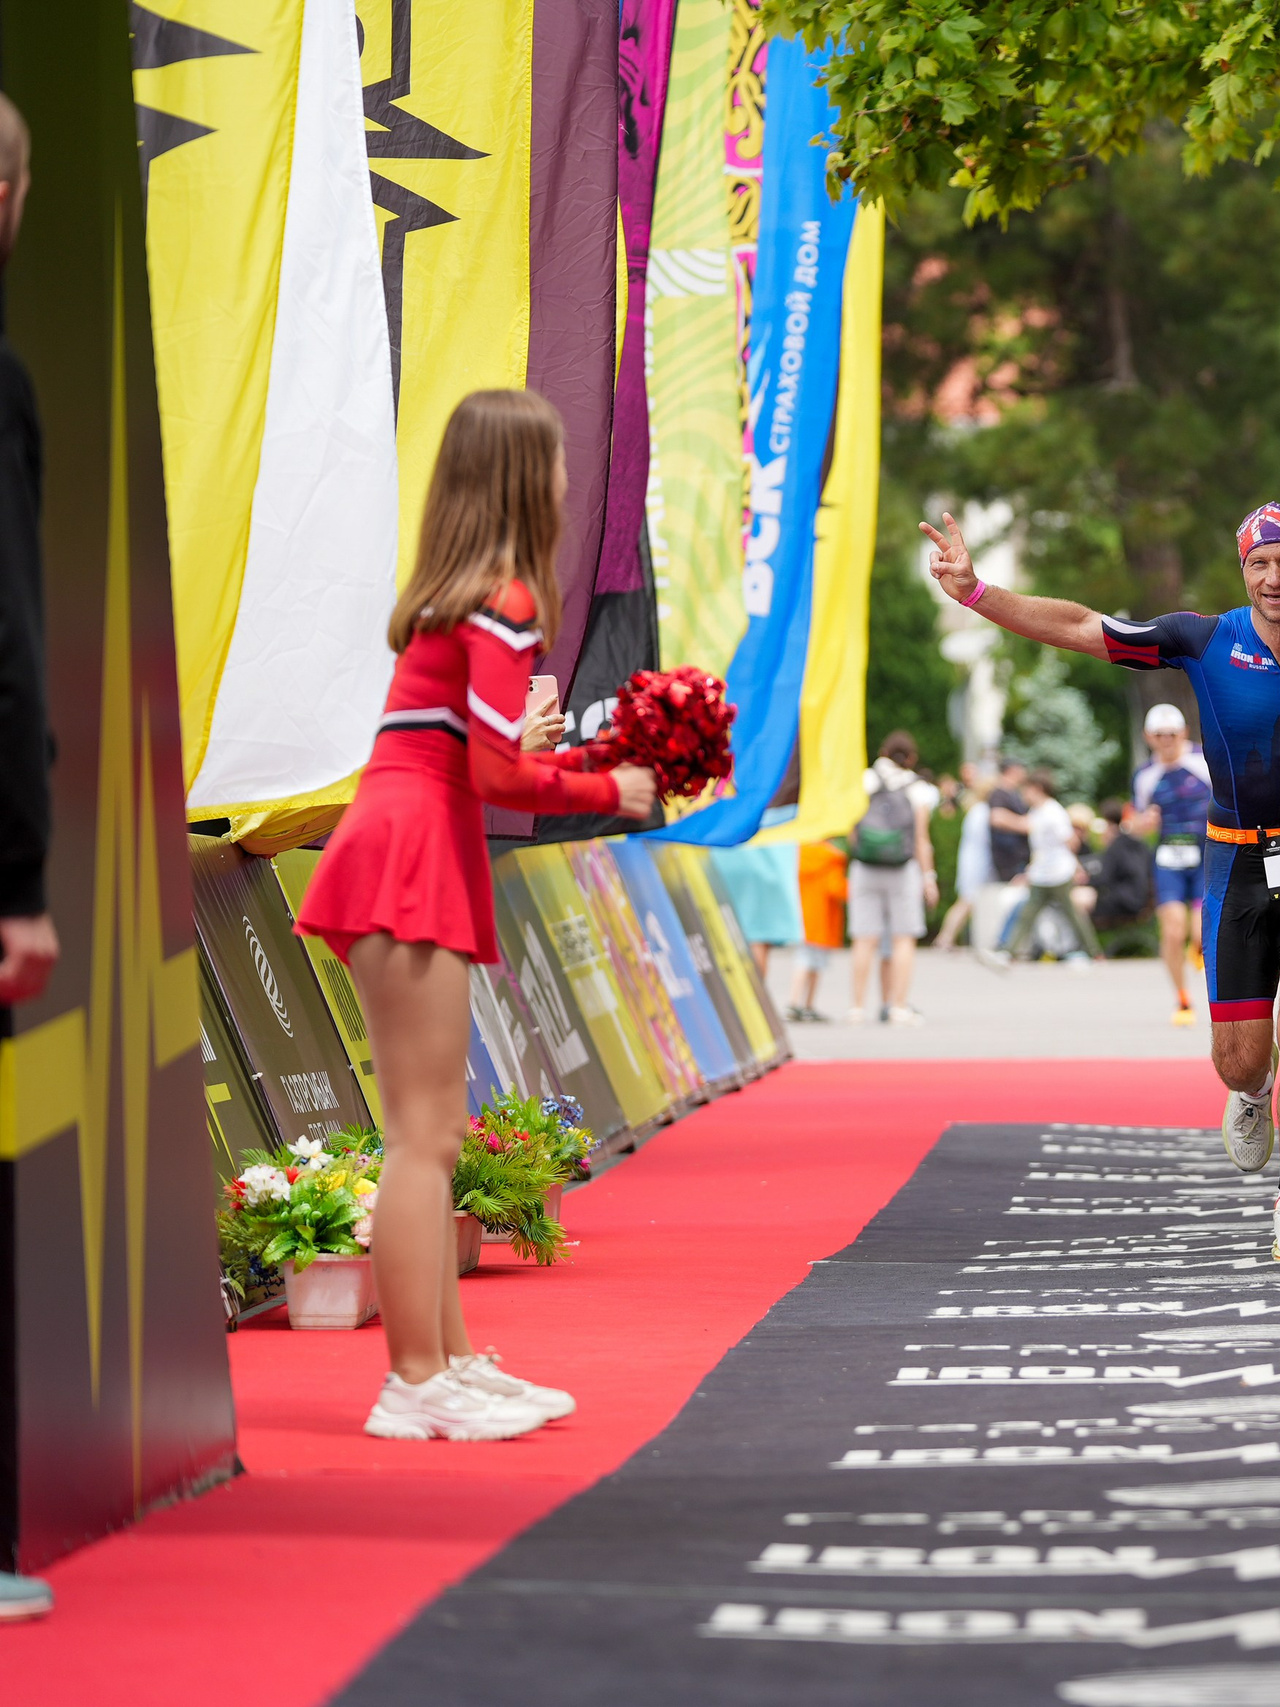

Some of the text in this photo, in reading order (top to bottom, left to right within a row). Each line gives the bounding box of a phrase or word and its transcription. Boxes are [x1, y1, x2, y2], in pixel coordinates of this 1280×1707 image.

[768, 220, 822, 455] СТРАХОВОЙ ДОМ
[933, 1300, 1184, 1316] IRON
[896, 1365, 1181, 1380] IRON
[841, 1444, 1172, 1465] IRON
[761, 1543, 1157, 1567] IRON
[711, 1602, 1145, 1637] IRON
